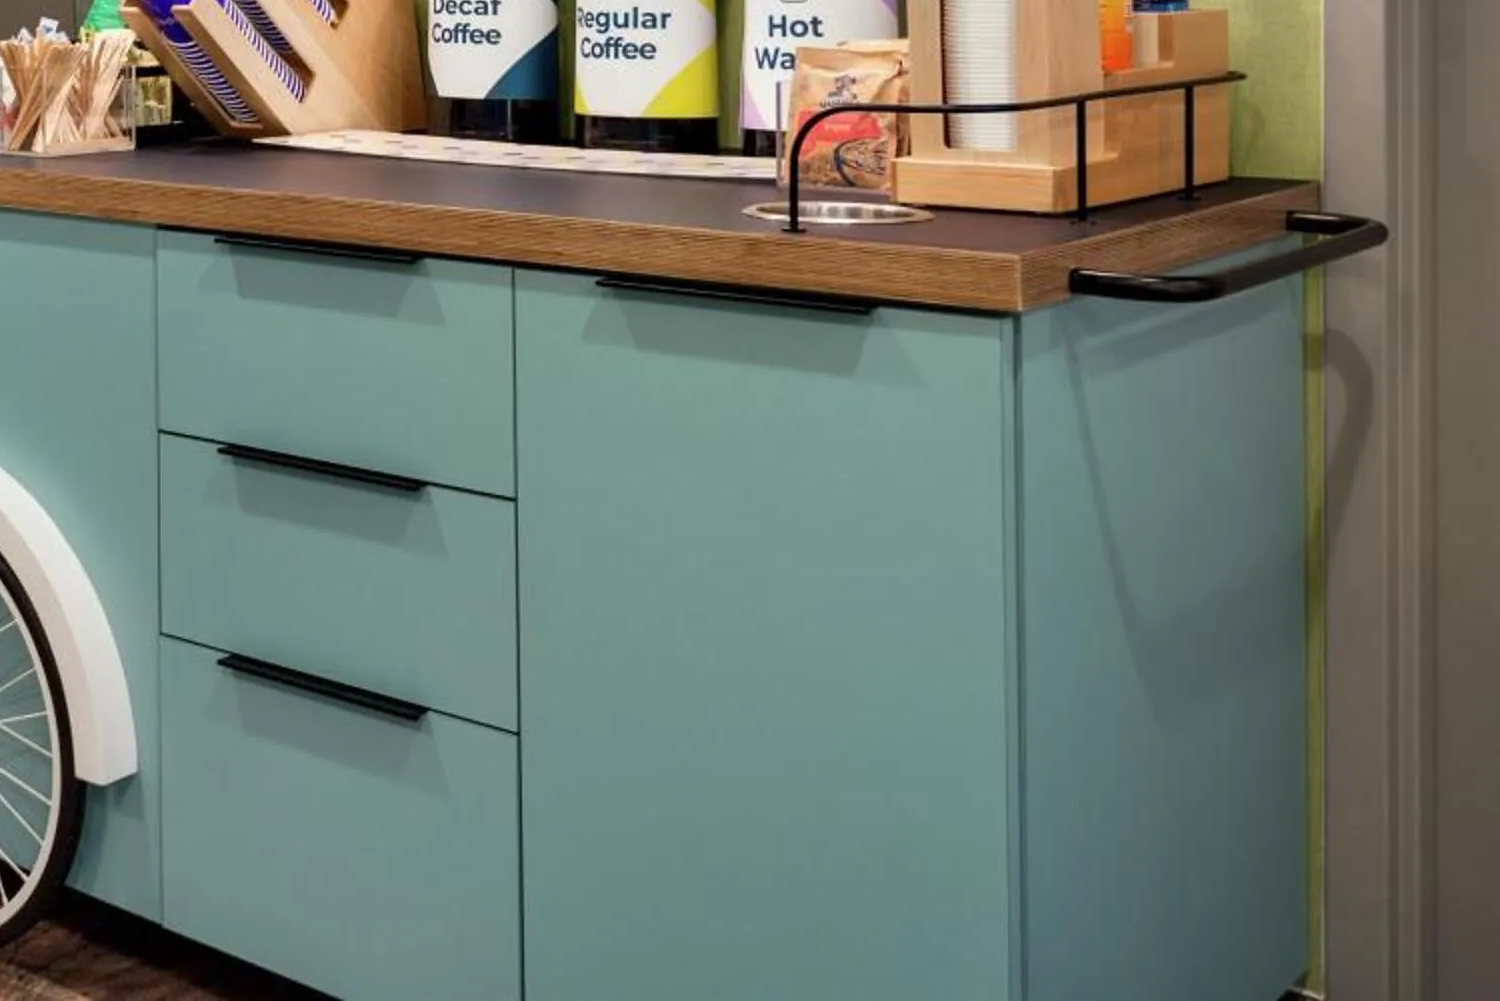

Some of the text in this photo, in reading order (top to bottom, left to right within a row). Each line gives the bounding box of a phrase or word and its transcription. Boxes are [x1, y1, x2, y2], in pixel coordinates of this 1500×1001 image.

[577, 6, 671, 34] Regular
[768, 14, 824, 38] Hot
[431, 22, 502, 45] Coffee
[581, 36, 657, 59] Coffee
